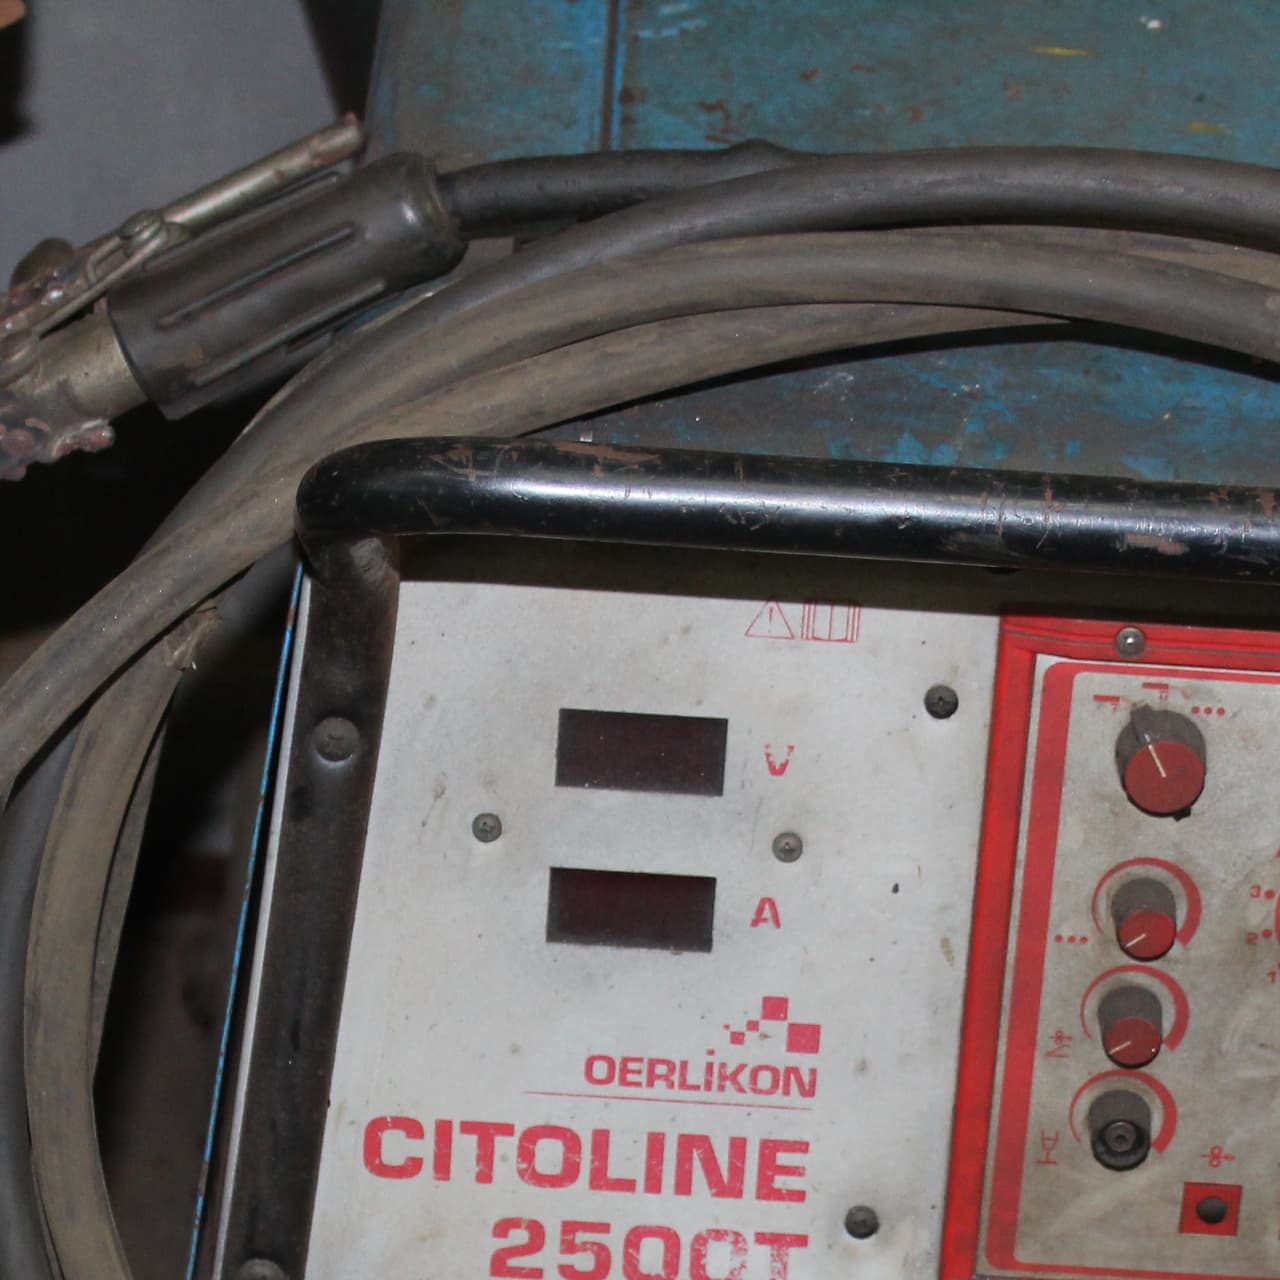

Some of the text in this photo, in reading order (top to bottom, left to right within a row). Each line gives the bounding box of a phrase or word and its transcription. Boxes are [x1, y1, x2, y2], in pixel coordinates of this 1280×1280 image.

[1249, 884, 1262, 899] 3
[751, 896, 782, 930] A
[1245, 931, 1259, 945] 2
[1267, 968, 1277, 984] 1
[583, 1048, 819, 1099] OERLIKON
[363, 1116, 811, 1203] CITOLINE
